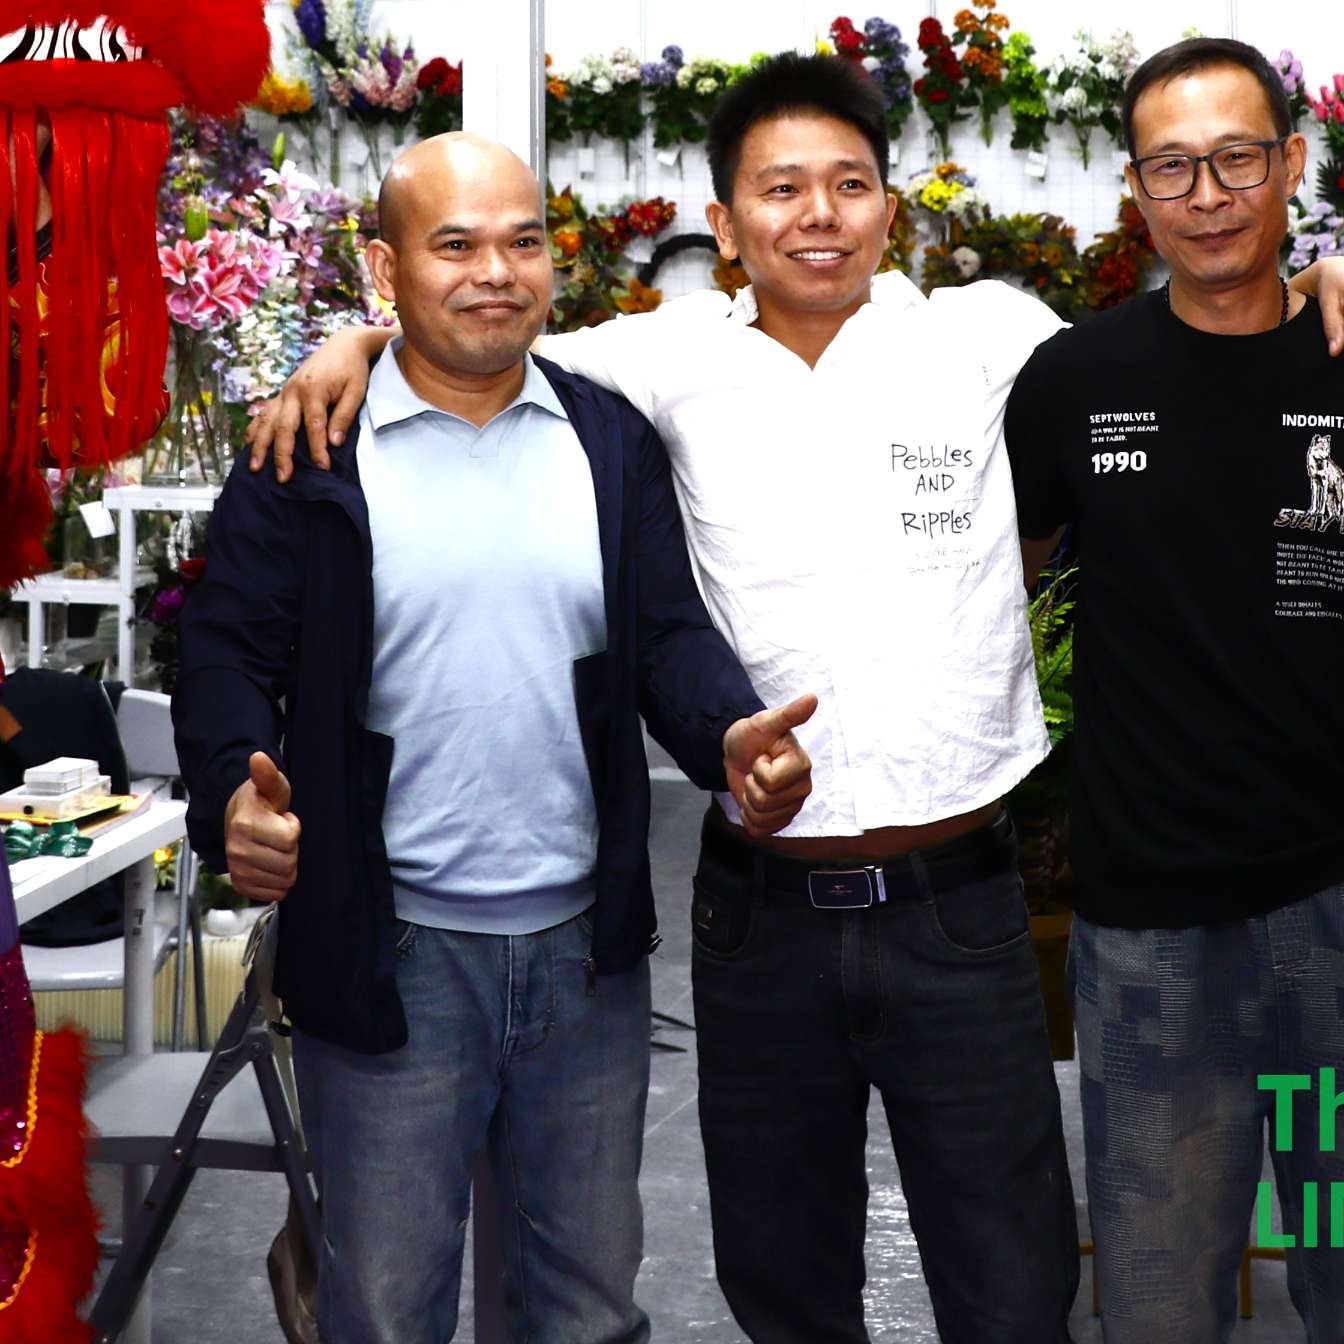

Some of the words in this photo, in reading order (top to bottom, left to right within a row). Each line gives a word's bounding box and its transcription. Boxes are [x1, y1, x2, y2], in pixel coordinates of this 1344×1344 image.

[1089, 411, 1156, 424] SEPTWOLVES
[1091, 450, 1147, 474] 1990
[915, 473, 954, 496] AND
[1273, 507, 1336, 533] STAY
